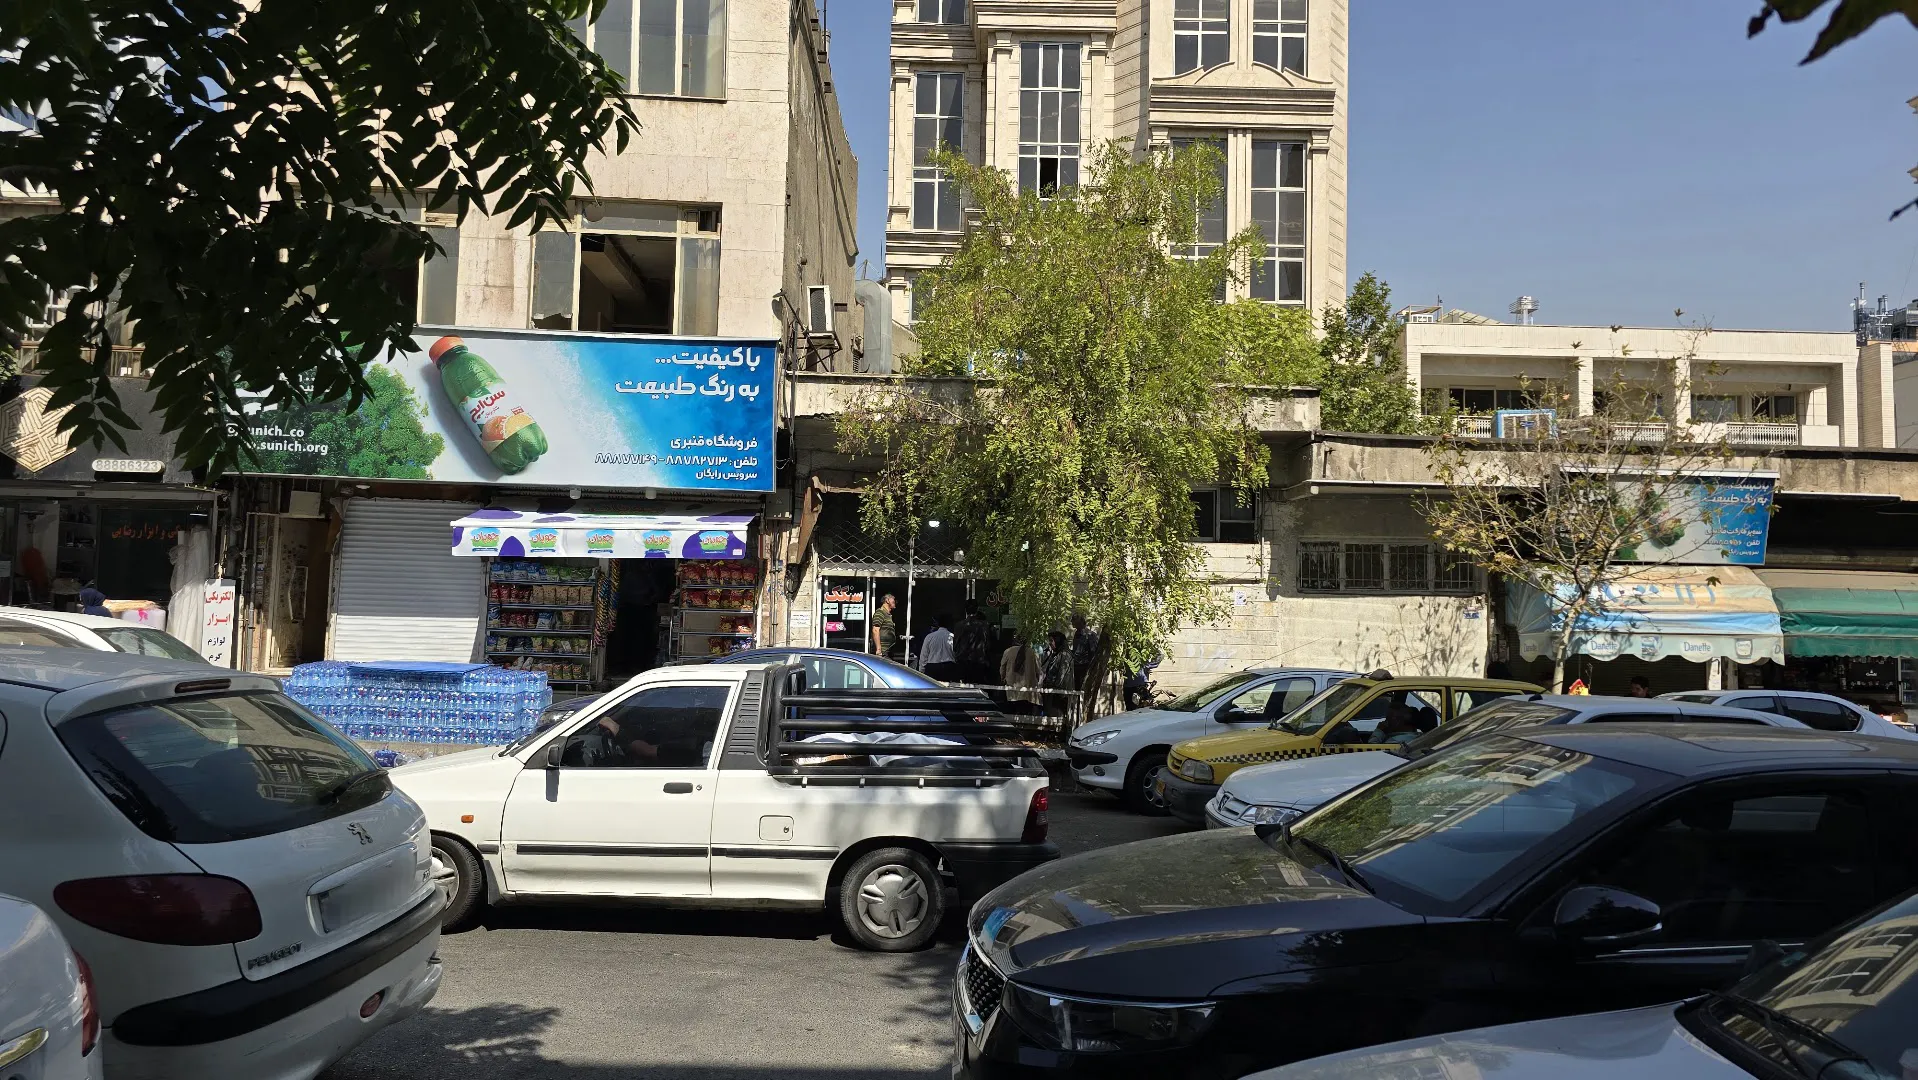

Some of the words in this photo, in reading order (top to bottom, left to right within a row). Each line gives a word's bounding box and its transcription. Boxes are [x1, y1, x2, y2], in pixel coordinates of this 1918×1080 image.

[615, 376, 696, 400] طبیعت
[699, 373, 735, 402] رنگ
[738, 384, 760, 401] به
[670, 435, 705, 449] قنبری
[706, 433, 758, 450] فروشگاه
[96, 460, 158, 471] 88886323
[695, 468, 722, 479] رایگان
[722, 471, 758, 481] سرویس
[205, 590, 234, 604] الکتریکی
[824, 585, 864, 603] سنگک
[207, 612, 231, 627] ابزار
[207, 636, 226, 647] لوازم
[1591, 640, 1618, 651] Danette
[1684, 641, 1711, 652] Danette
[247, 940, 303, 971] PEUGEOT
